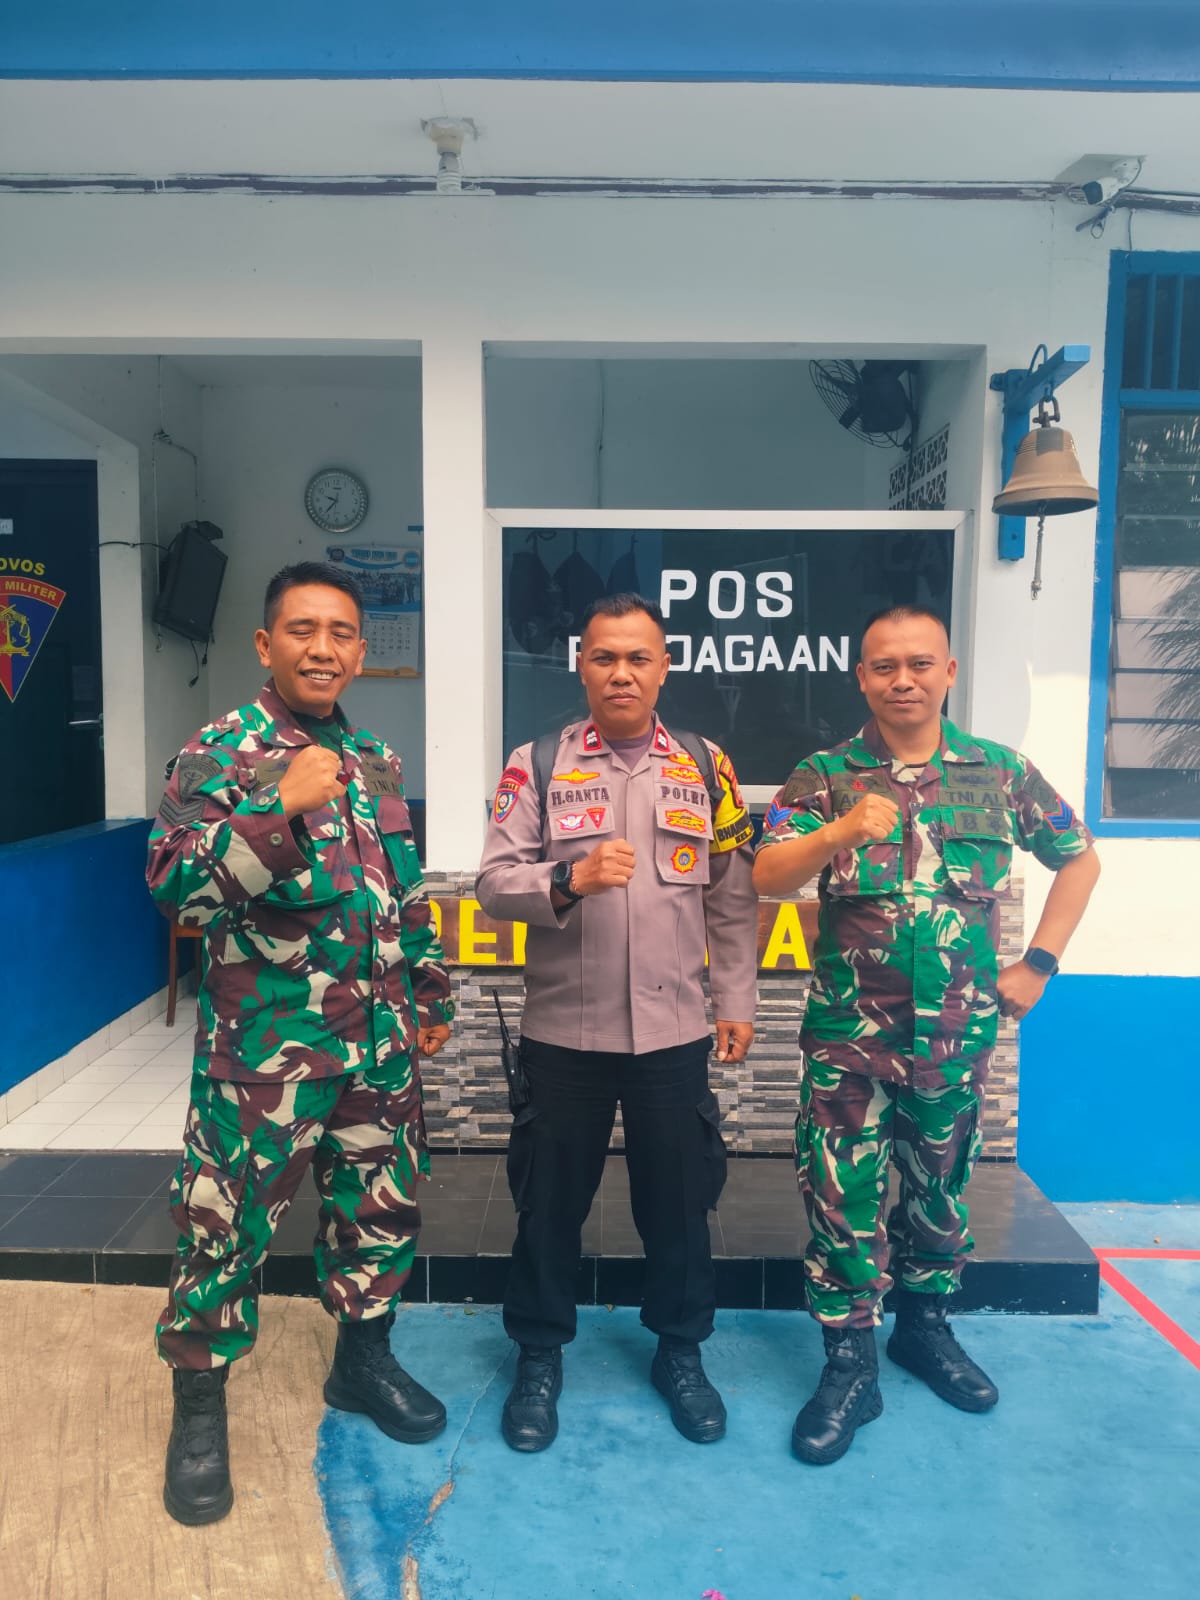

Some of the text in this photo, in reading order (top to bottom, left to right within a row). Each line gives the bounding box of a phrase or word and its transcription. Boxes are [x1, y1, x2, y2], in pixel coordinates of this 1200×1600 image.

[5, 581, 57, 601] MILITER
[660, 569, 793, 619] POS
[568, 634, 850, 673] JAGAAN
[551, 787, 610, 806] H.GANTA
[661, 786, 705, 806] POLRI
